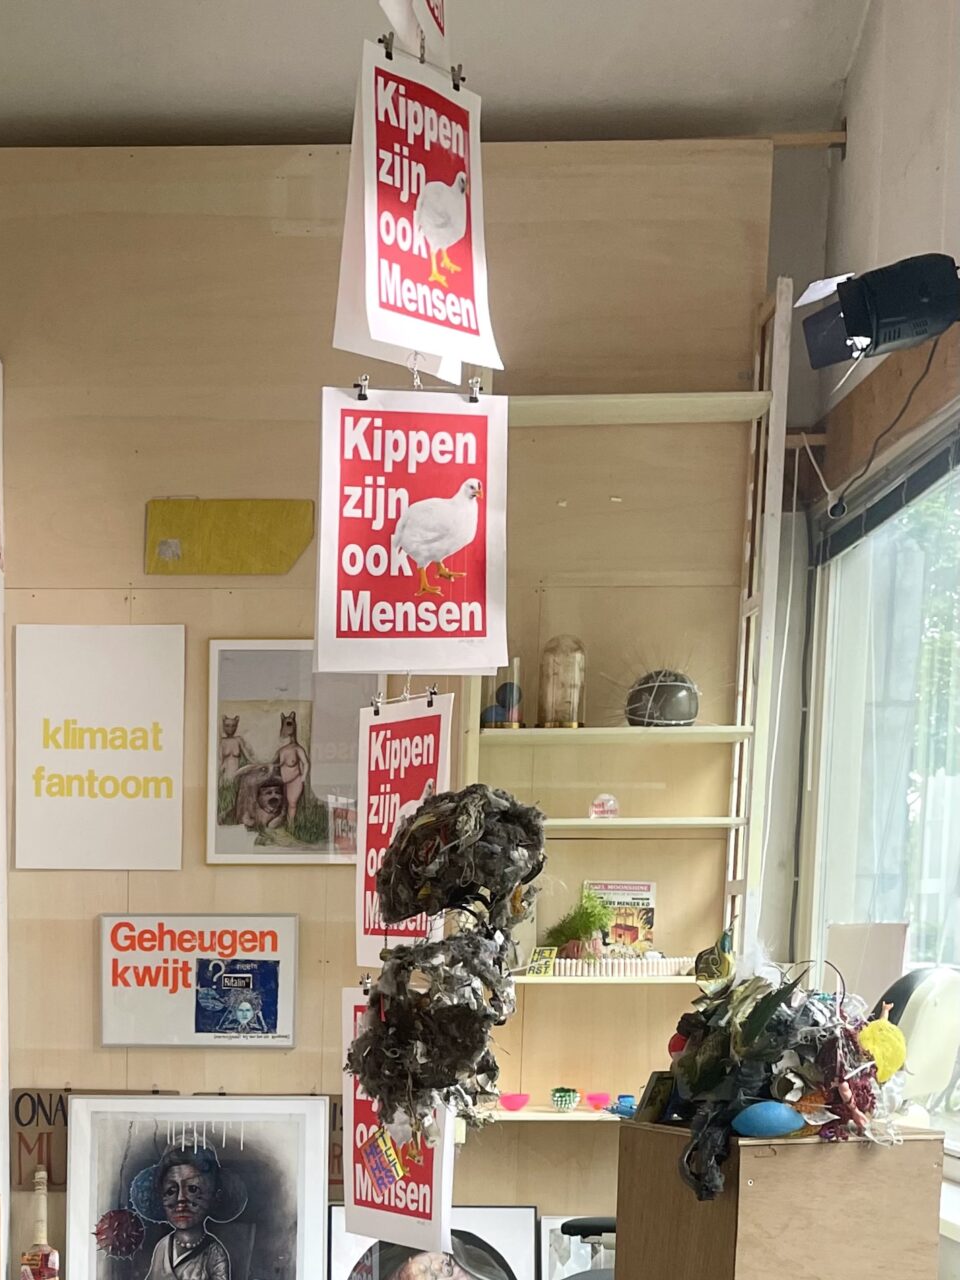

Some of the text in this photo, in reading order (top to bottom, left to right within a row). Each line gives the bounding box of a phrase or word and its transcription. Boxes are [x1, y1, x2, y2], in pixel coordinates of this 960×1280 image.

[377, 75, 465, 157] Kippen
[378, 142, 427, 203] zijn
[379, 209, 428, 260] ook
[379, 258, 478, 330] Mensen
[343, 415, 477, 474] Kippen
[342, 476, 410, 531] zijn
[341, 534, 415, 577] ook
[340, 589, 483, 633] Mensen
[42, 718, 163, 752] klimaat
[370, 730, 435, 780] Kippen
[32, 766, 173, 800] fantoom
[368, 784, 401, 834] zijn
[110, 921, 278, 959] Geheugen
[111, 958, 193, 994] kwijt
